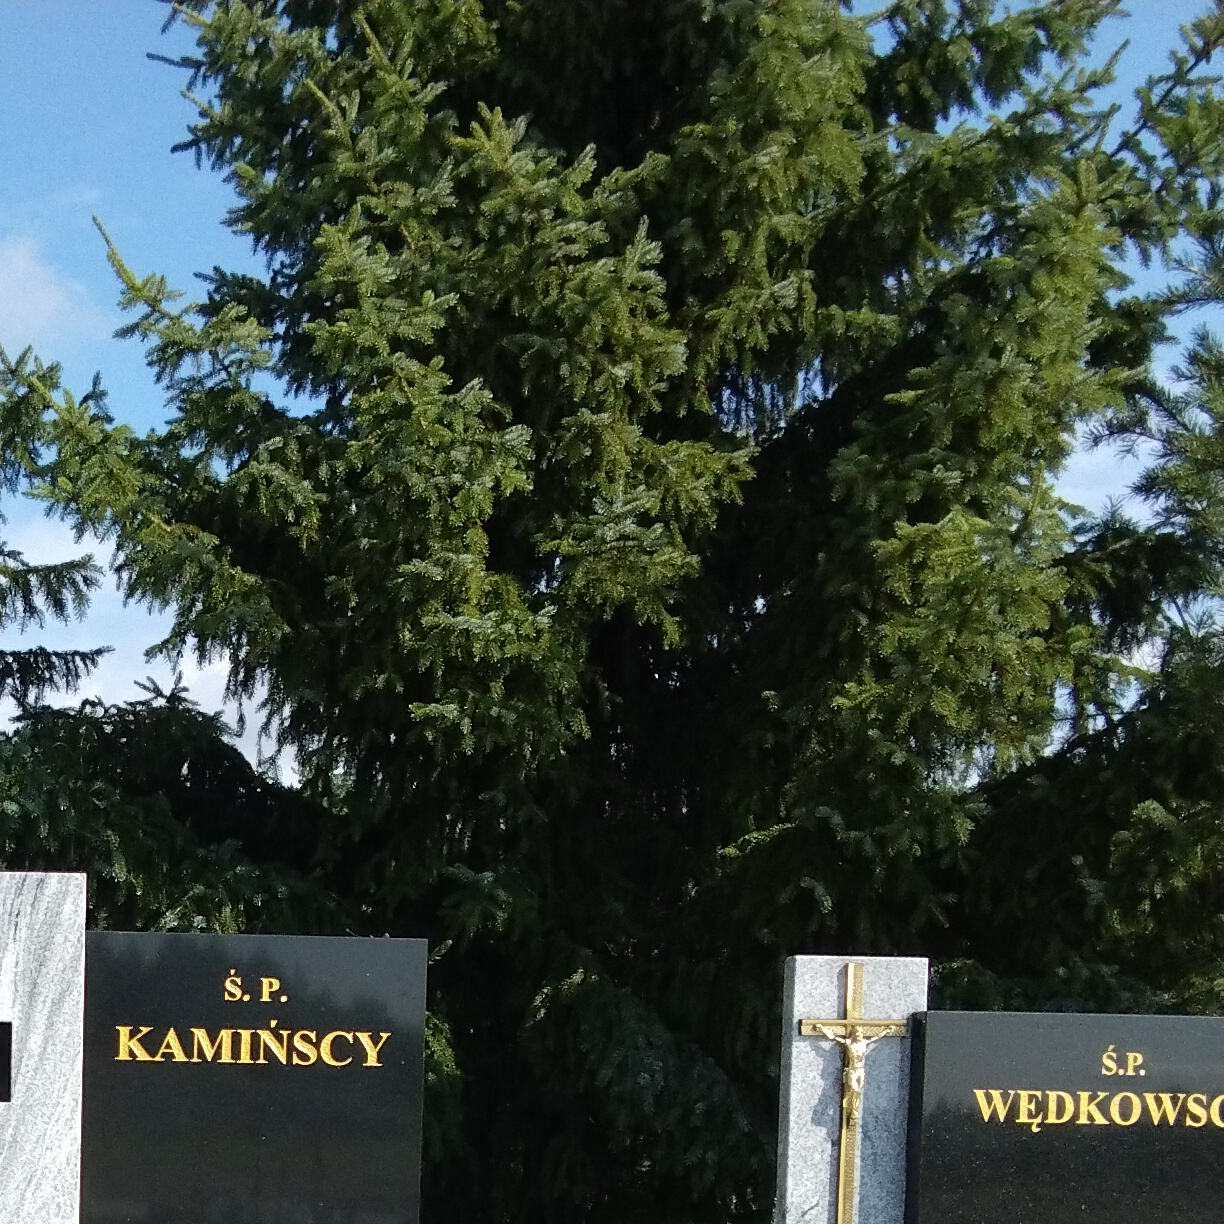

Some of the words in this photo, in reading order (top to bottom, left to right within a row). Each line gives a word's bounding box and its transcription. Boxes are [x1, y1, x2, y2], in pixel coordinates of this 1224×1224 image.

[223, 969, 251, 1002] Ś.
[260, 977, 288, 1003] P.
[114, 1020, 392, 1067] KAMIŃSCY
[1101, 1045, 1146, 1077] Ś.P.
